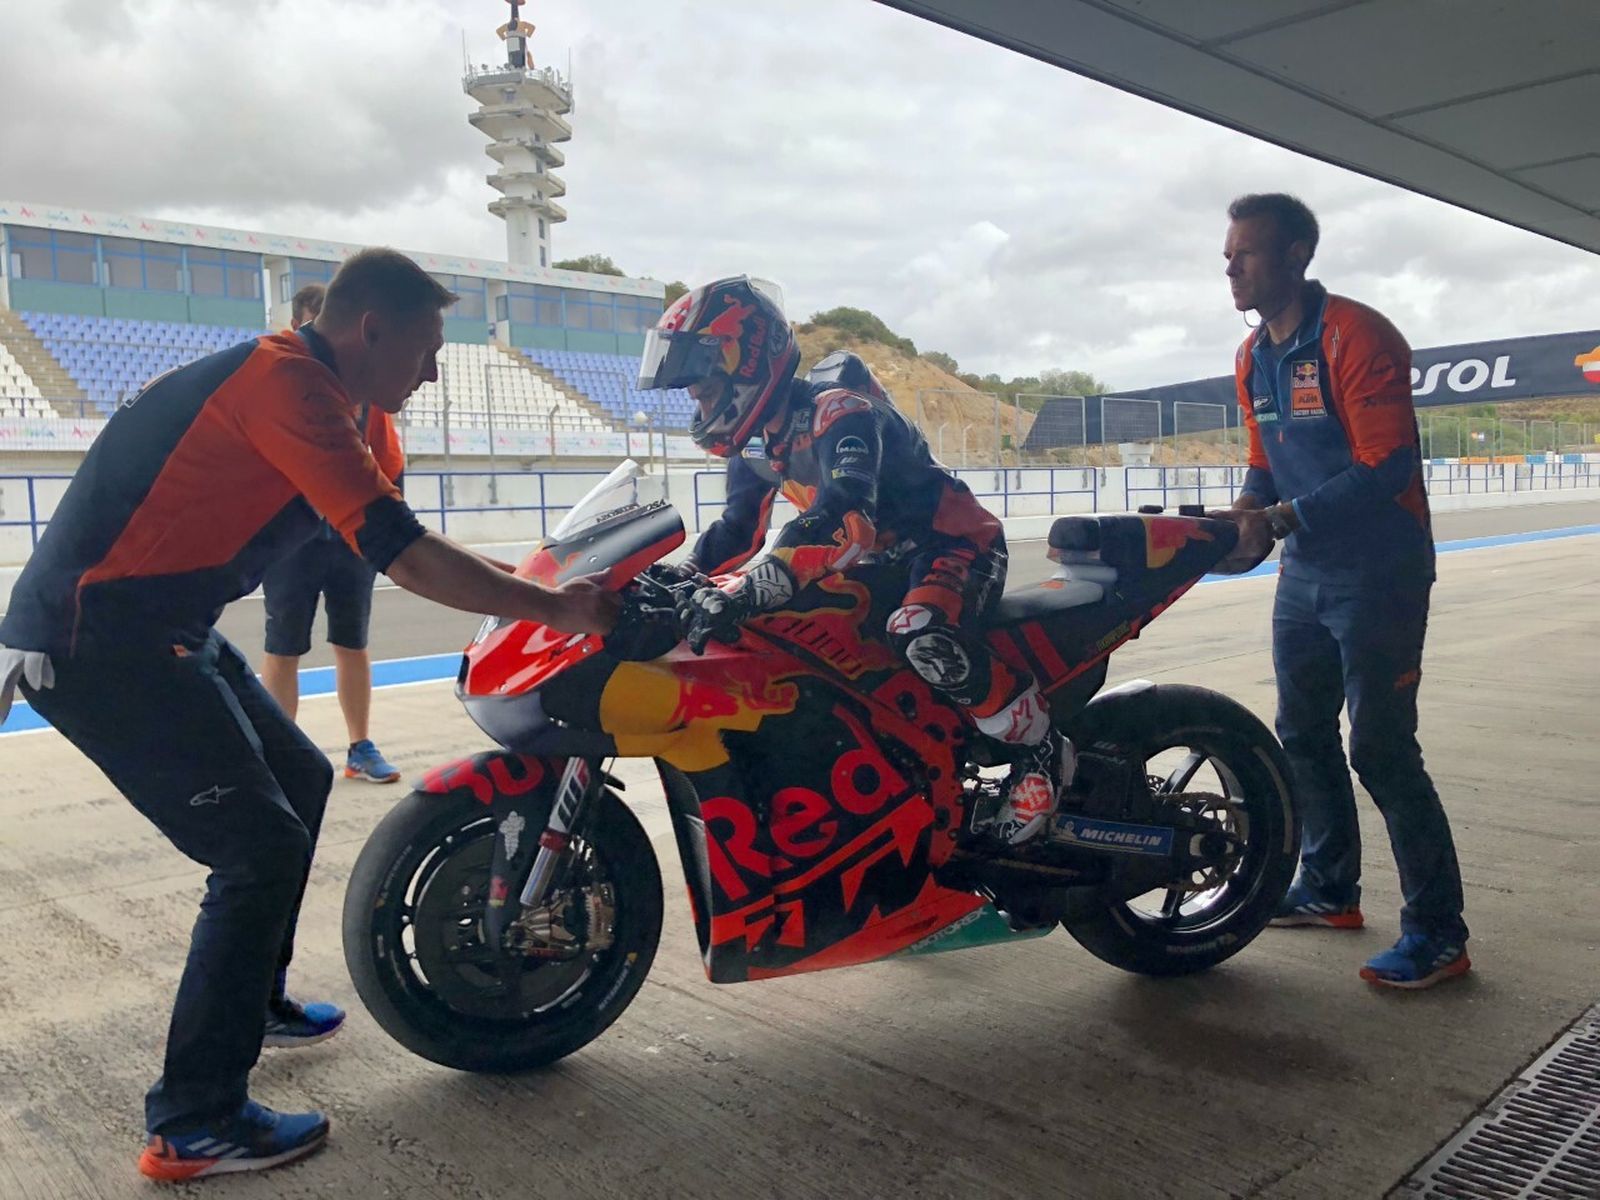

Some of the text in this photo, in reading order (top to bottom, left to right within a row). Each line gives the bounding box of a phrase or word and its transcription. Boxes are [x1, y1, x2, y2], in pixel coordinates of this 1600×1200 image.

[740, 345, 760, 378] Red
[700, 703, 911, 901] Red
[1080, 827, 1162, 847] MICHELIN
[910, 906, 988, 952] MOTOREX
